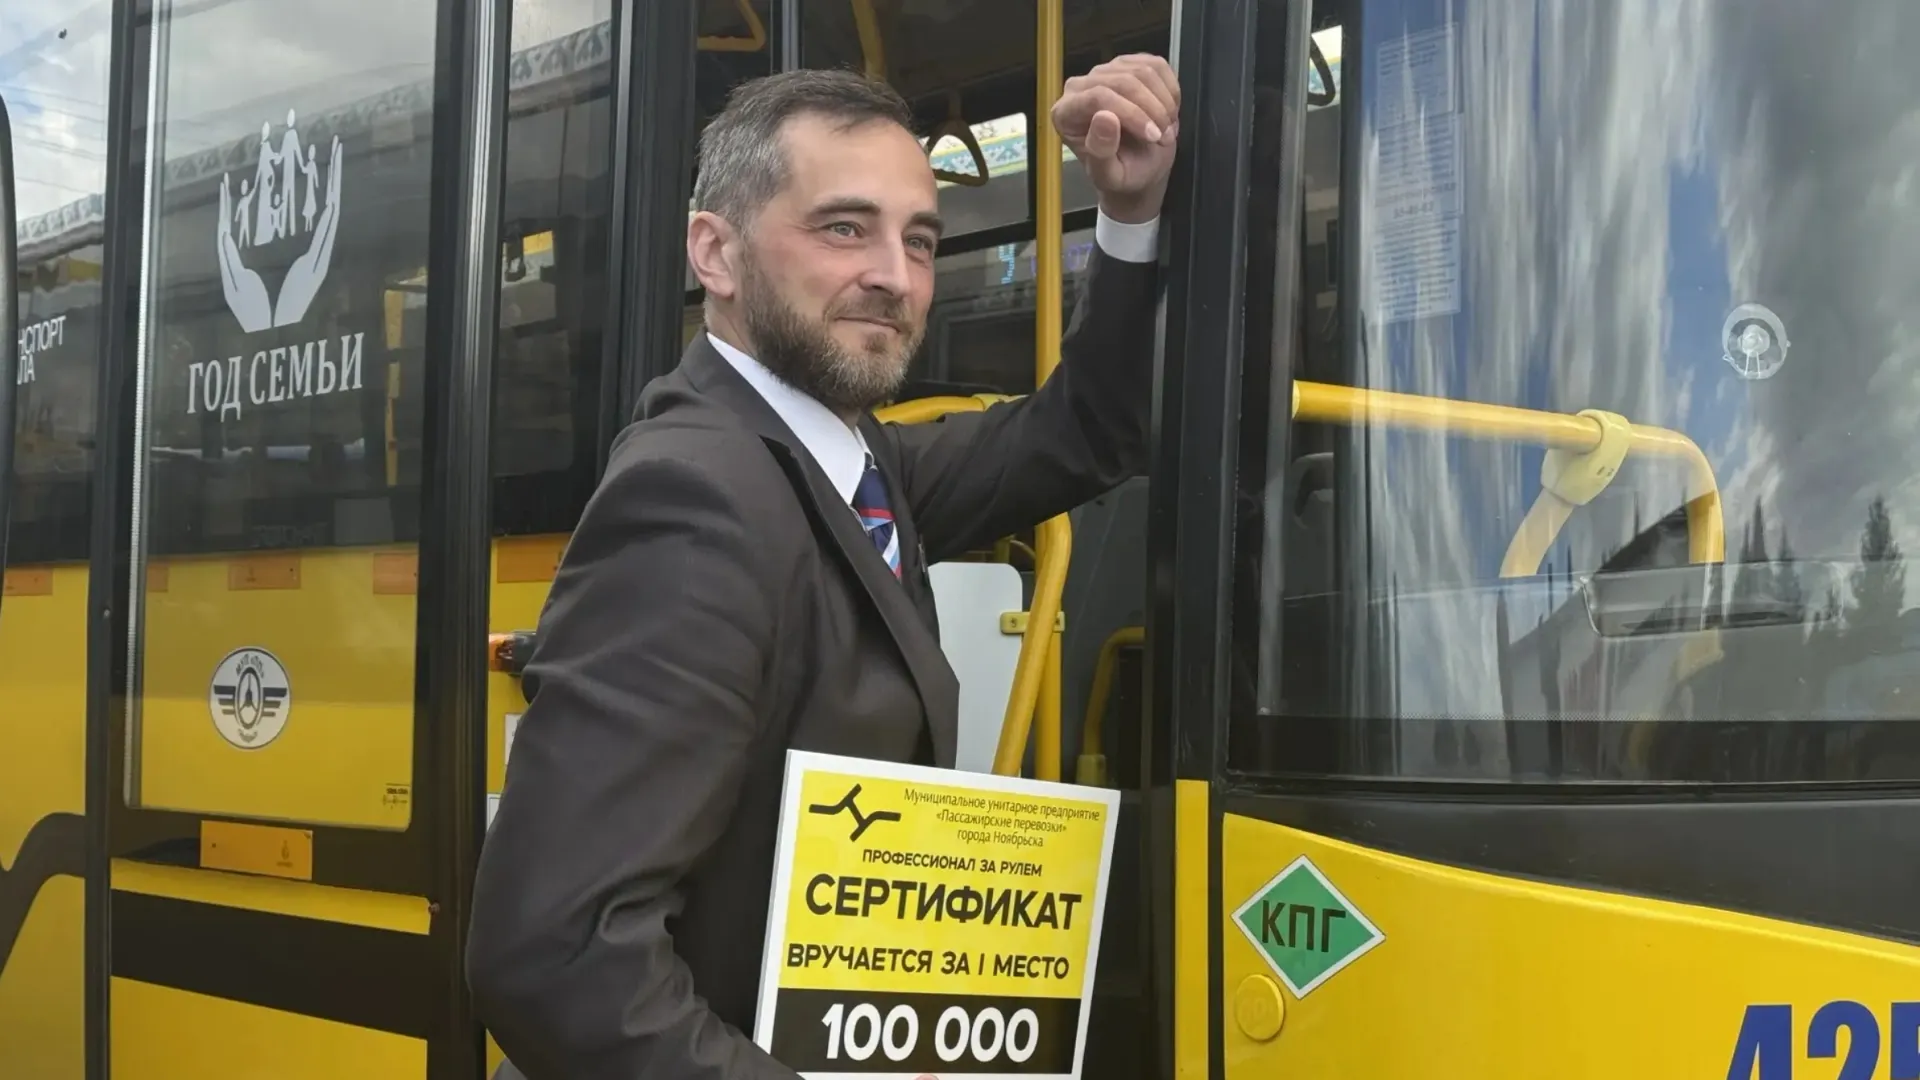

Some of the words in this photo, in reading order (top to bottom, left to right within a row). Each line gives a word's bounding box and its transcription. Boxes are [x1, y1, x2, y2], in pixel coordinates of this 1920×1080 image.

[187, 355, 243, 423] ГОД
[250, 332, 365, 405] СЕМЬИ
[904, 788, 986, 809] Муниципальное
[987, 798, 1039, 816] унитарное
[1040, 804, 1101, 822] предприятие
[936, 808, 1012, 829] «Пассажирские
[1014, 819, 1068, 833] перевозки»
[957, 829, 991, 845] города
[993, 831, 1044, 849] Ноябрьска
[862, 849, 976, 872] ПРОФЕССИОНАЛ
[980, 859, 997, 873] ЗА
[1000, 861, 1044, 877] РУЛЕМ
[805, 873, 1083, 931] СЕРТИФИКАТ
[1262, 899, 1346, 953] КПГ
[786, 943, 933, 974] ВРУЧАЕТСЯ
[940, 951, 970, 976] ЗА
[992, 955, 1070, 980] МЕСТО
[821, 1002, 920, 1061] 100
[934, 1005, 1040, 1063] 000
